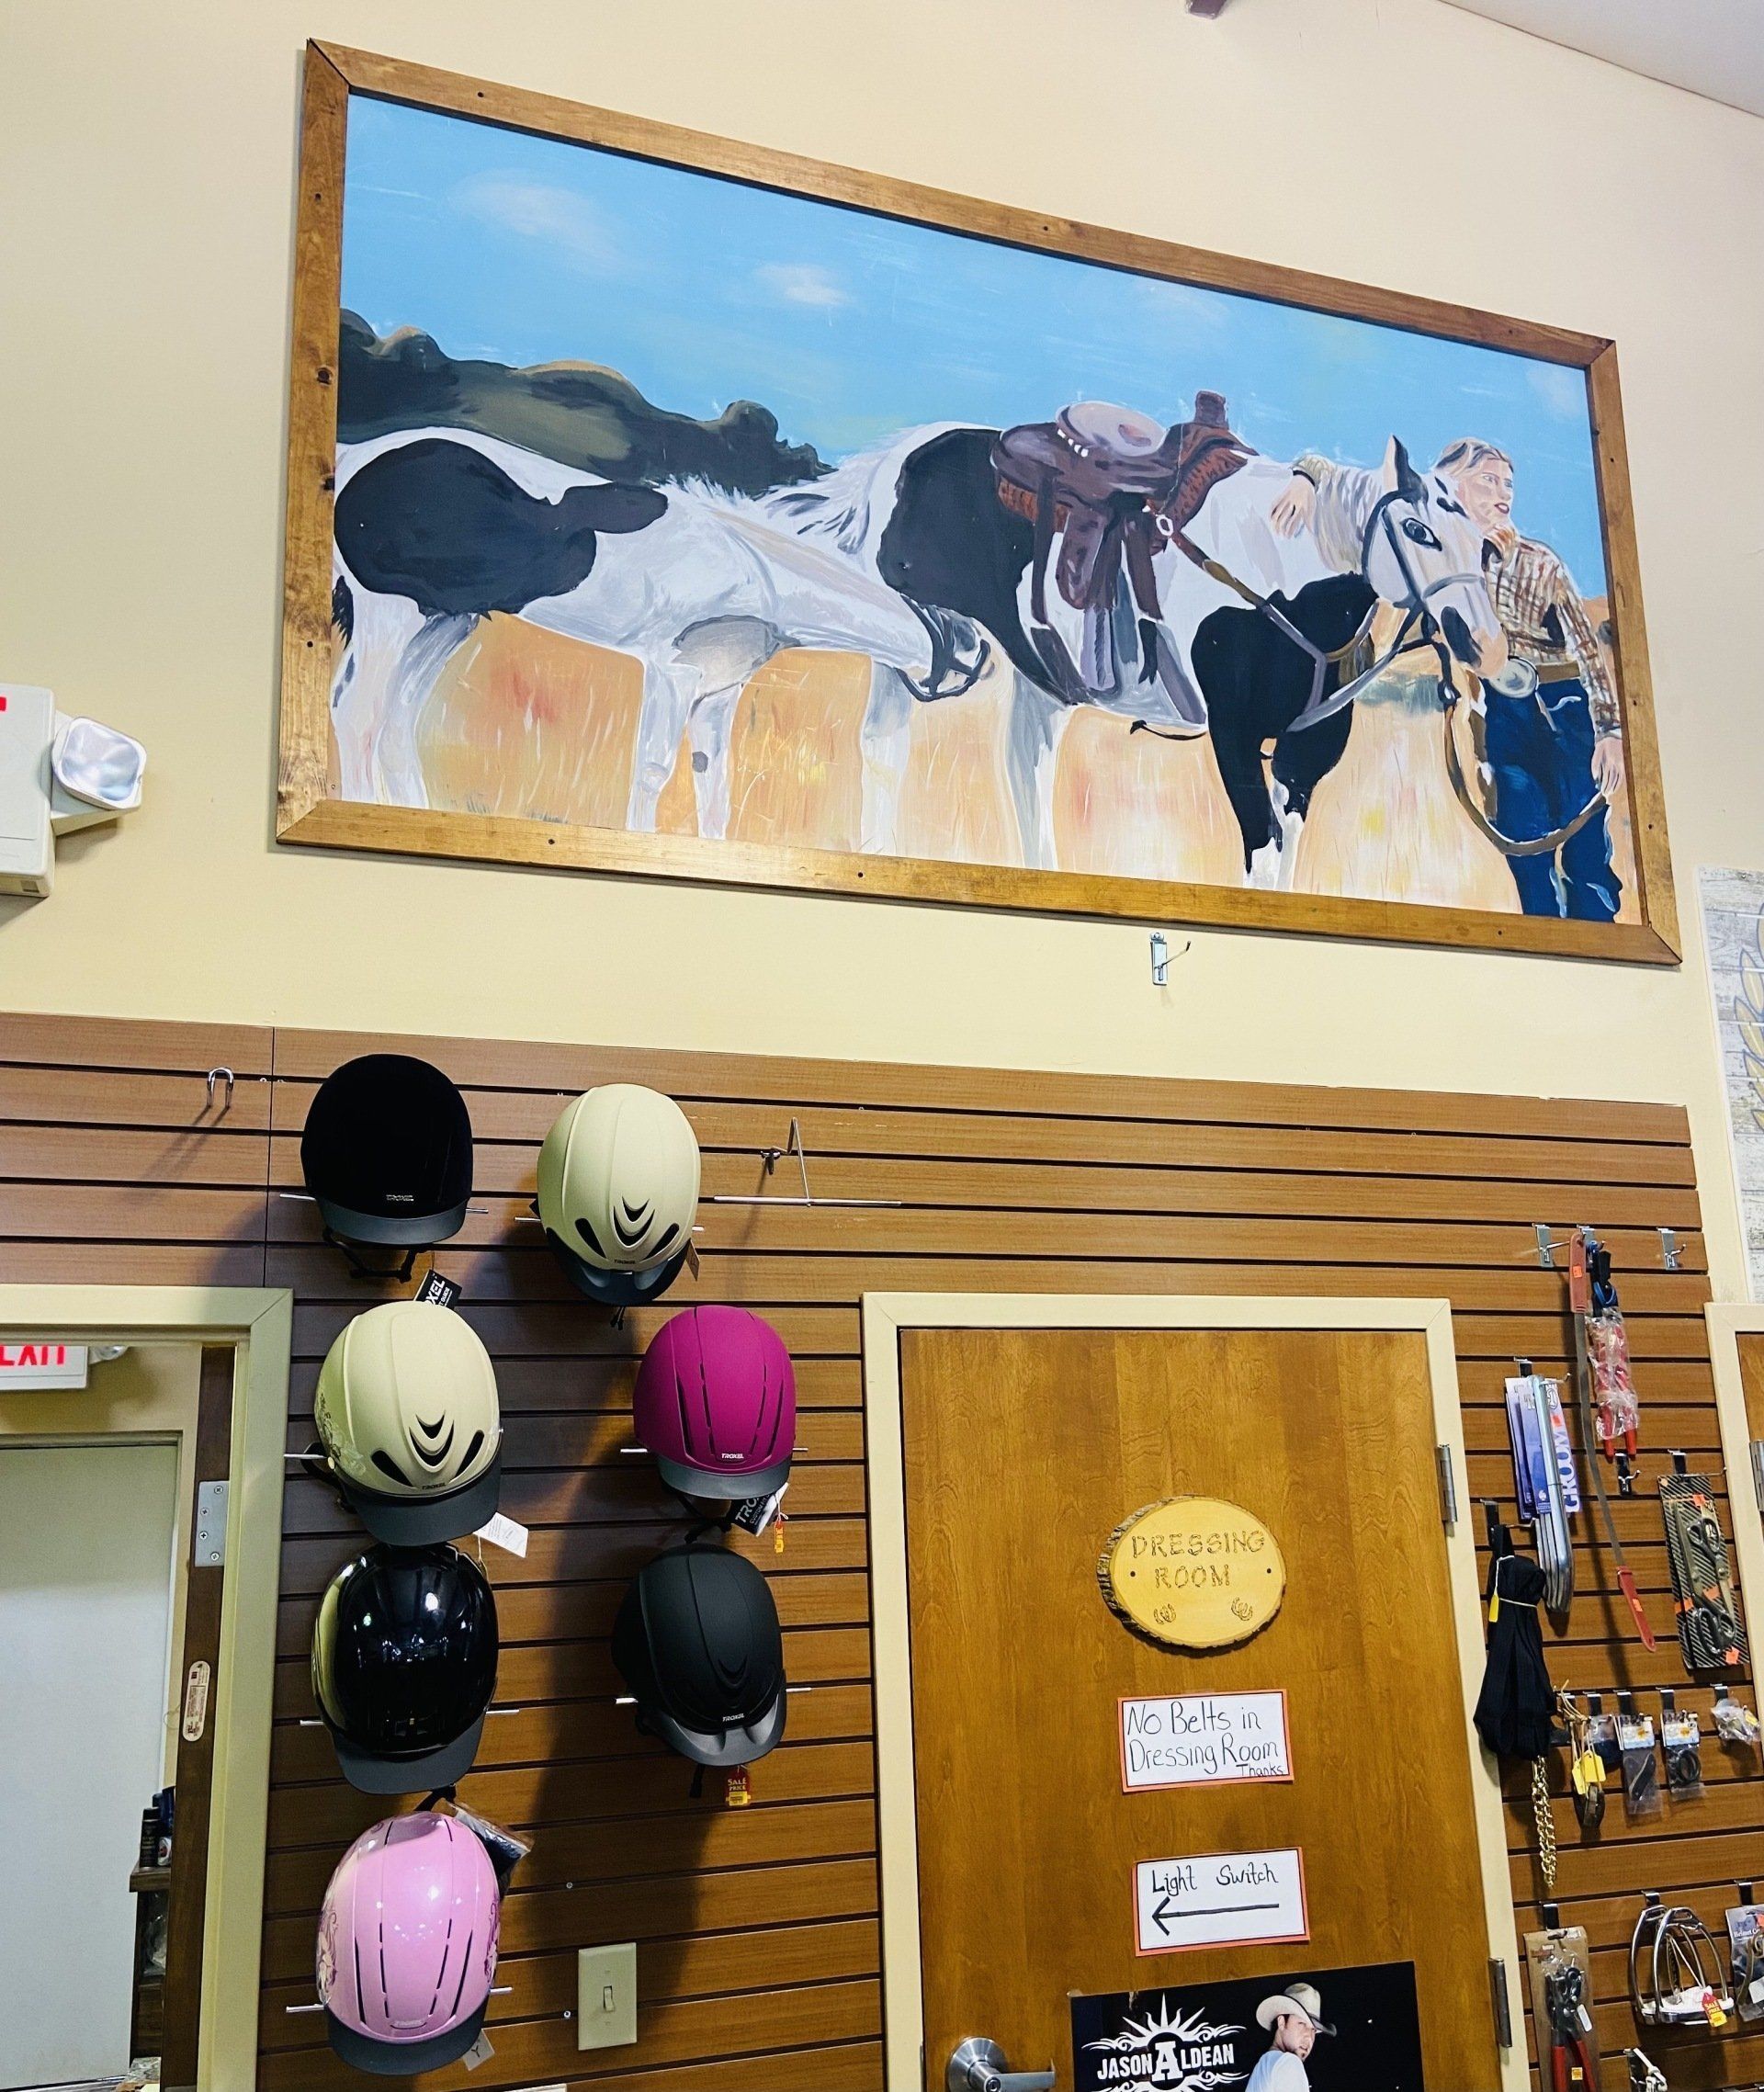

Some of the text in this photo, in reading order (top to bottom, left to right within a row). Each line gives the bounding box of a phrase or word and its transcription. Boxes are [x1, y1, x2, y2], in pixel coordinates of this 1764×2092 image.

[735, 1497, 759, 1523] TRO
[1131, 1530, 1265, 1559] DRESSING
[1154, 1564, 1231, 1589] ROOM
[1126, 1700, 1262, 1736] No Belts in
[1128, 1732, 1279, 1775] Dressing Room
[728, 1777, 747, 1786] SALE
[1236, 1763, 1284, 1777] Thanks
[1151, 1861, 1280, 1897] Light Switch
[1096, 2041, 1235, 2082] JASON ALDEAN
